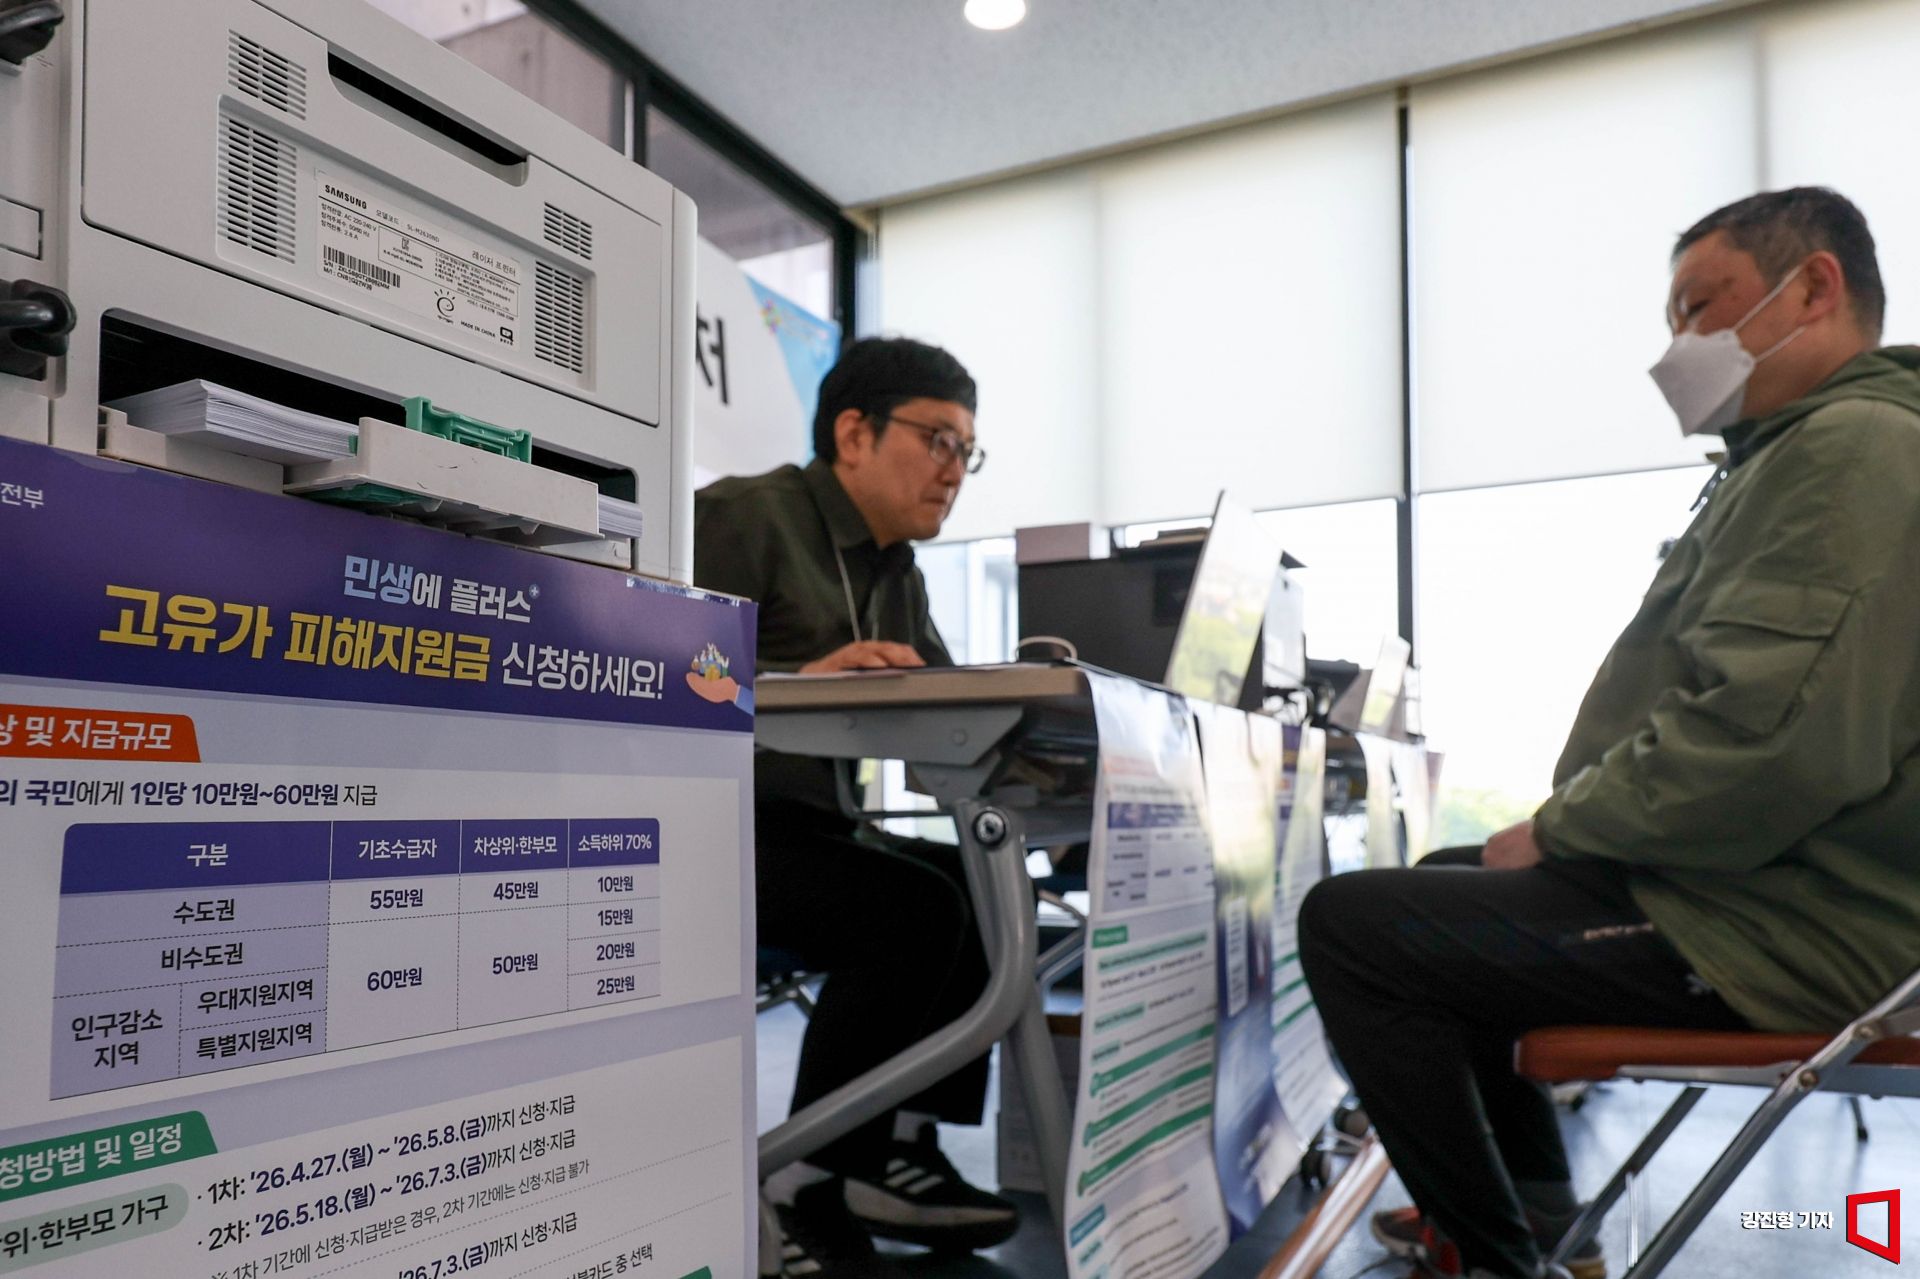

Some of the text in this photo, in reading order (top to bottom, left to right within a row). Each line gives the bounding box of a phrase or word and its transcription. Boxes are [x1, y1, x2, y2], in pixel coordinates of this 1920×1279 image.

[325, 185, 367, 209] SAMSUNG
[472, 250, 516, 277] 레이저 프린터
[460, 320, 473, 330] MADE
[481, 328, 496, 338] CHINA
[1, 482, 44, 509] 전부
[343, 554, 442, 609] 민생에
[99, 584, 665, 700] 고유가 피해지원금 신청하세요!
[25, 716, 56, 747] 및
[61, 718, 172, 751] 지급규모
[0, 779, 378, 806] 의 국민에게 1인당 10만원~60만원 지급
[187, 843, 229, 867] 구분
[357, 838, 437, 860] 기초수급자
[577, 833, 652, 853] 소득하위 70%
[493, 881, 539, 901] 45만원
[598, 876, 634, 893] 10만원
[173, 898, 235, 925] 수도권
[370, 888, 424, 910] 55만원
[598, 908, 634, 927] 15만원
[161, 942, 244, 971] 비수도권
[492, 953, 539, 975] 50만원
[596, 942, 635, 961] 20만원
[367, 967, 423, 992] 60만원
[596, 975, 635, 996] 25만원
[197, 979, 314, 1014] 우대지원지역
[71, 1008, 163, 1042] 인구감소
[196, 1022, 313, 1060] 특별지원지역
[94, 1041, 139, 1069] 지역
[0, 1123, 182, 1190] 청방법 및 일정
[207, 1176, 246, 1205] 1차:
[250, 1143, 373, 1194] '26.4.27.(월)
[394, 1108, 515, 1156] '26.5.8.(금)까지
[121, 1194, 169, 1225] 가구
[208, 1220, 251, 1251] 2차:
[255, 1182, 376, 1236] '26.5.18.(월)
[396, 1145, 515, 1195] '26.7.3.(금)까지
[263, 1243, 311, 1274] 기간에
[410, 1206, 440, 1228] 경우,
[443, 1196, 465, 1218] 2차
[468, 1184, 516, 1210] 기간에는
[569, 1159, 590, 1180] 불가
[616, 1253, 628, 1274] 중
[630, 1243, 653, 1268] 선택
